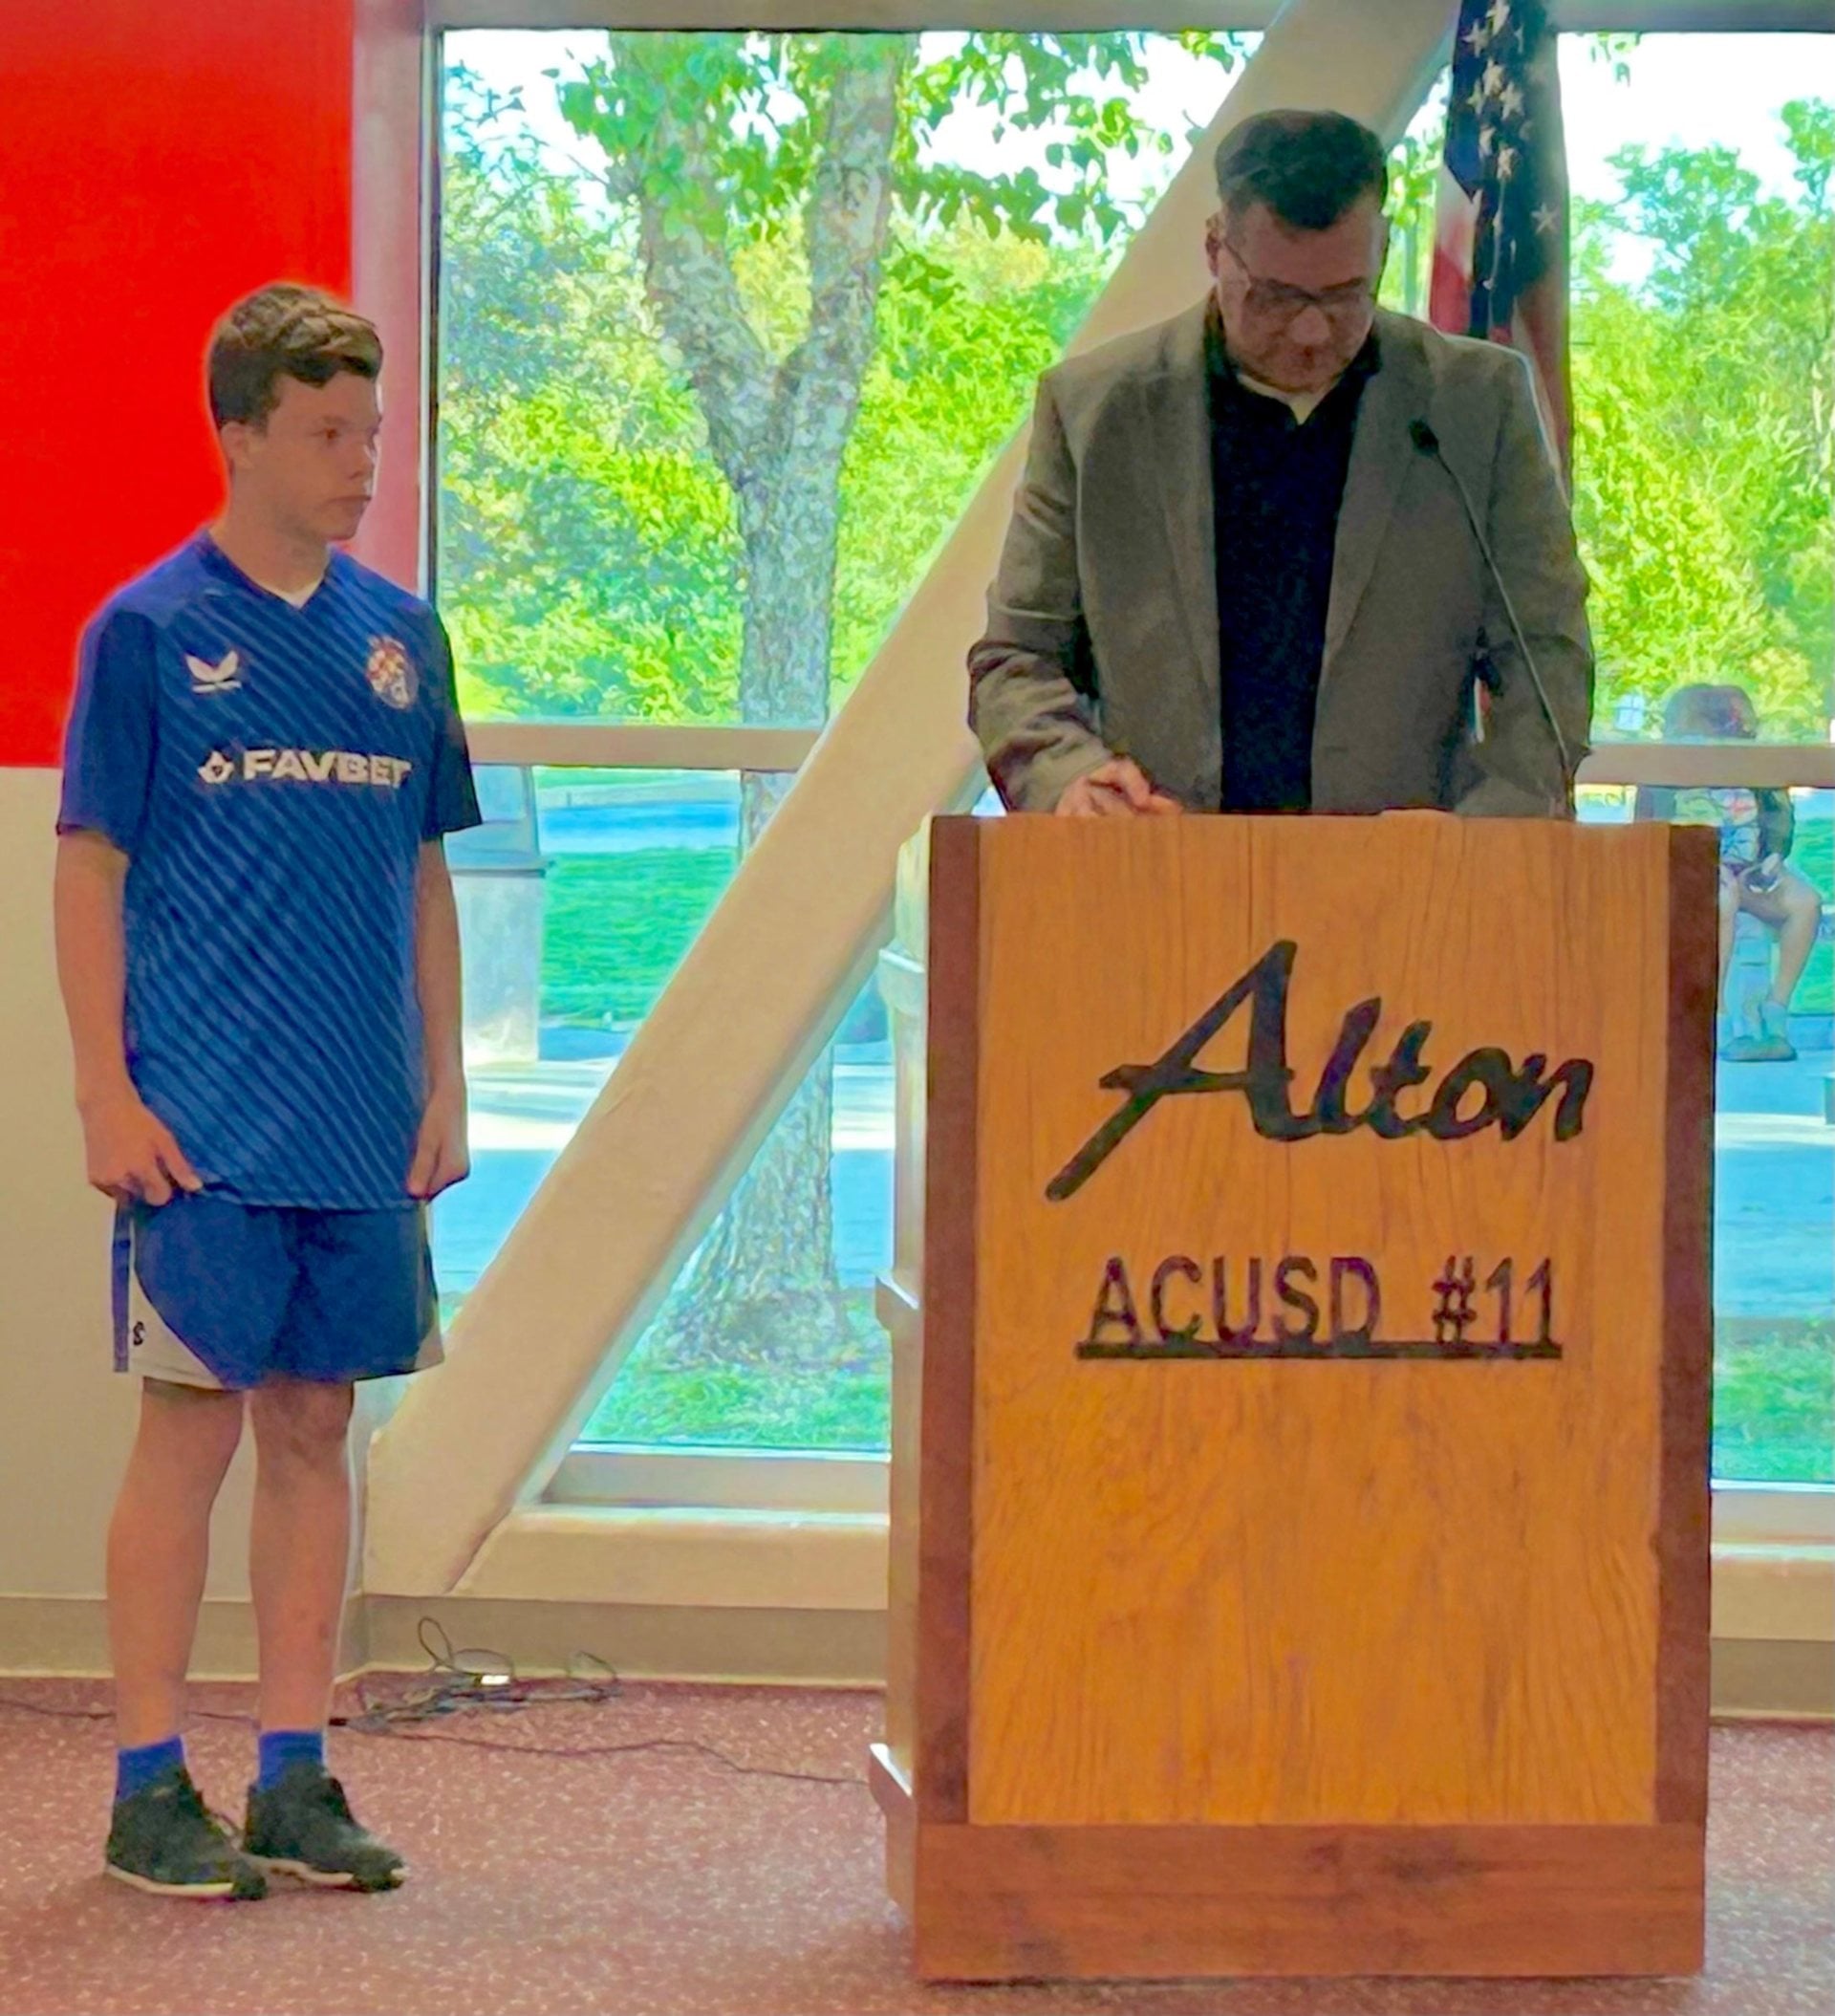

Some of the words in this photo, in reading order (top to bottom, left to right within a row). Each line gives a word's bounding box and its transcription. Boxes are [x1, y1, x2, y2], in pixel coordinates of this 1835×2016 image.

[243, 748, 412, 789] FAVBET
[1046, 940, 1594, 1202] Alton
[1089, 1256, 1382, 1343] ACUSD
[1432, 1256, 1554, 1343] #11
